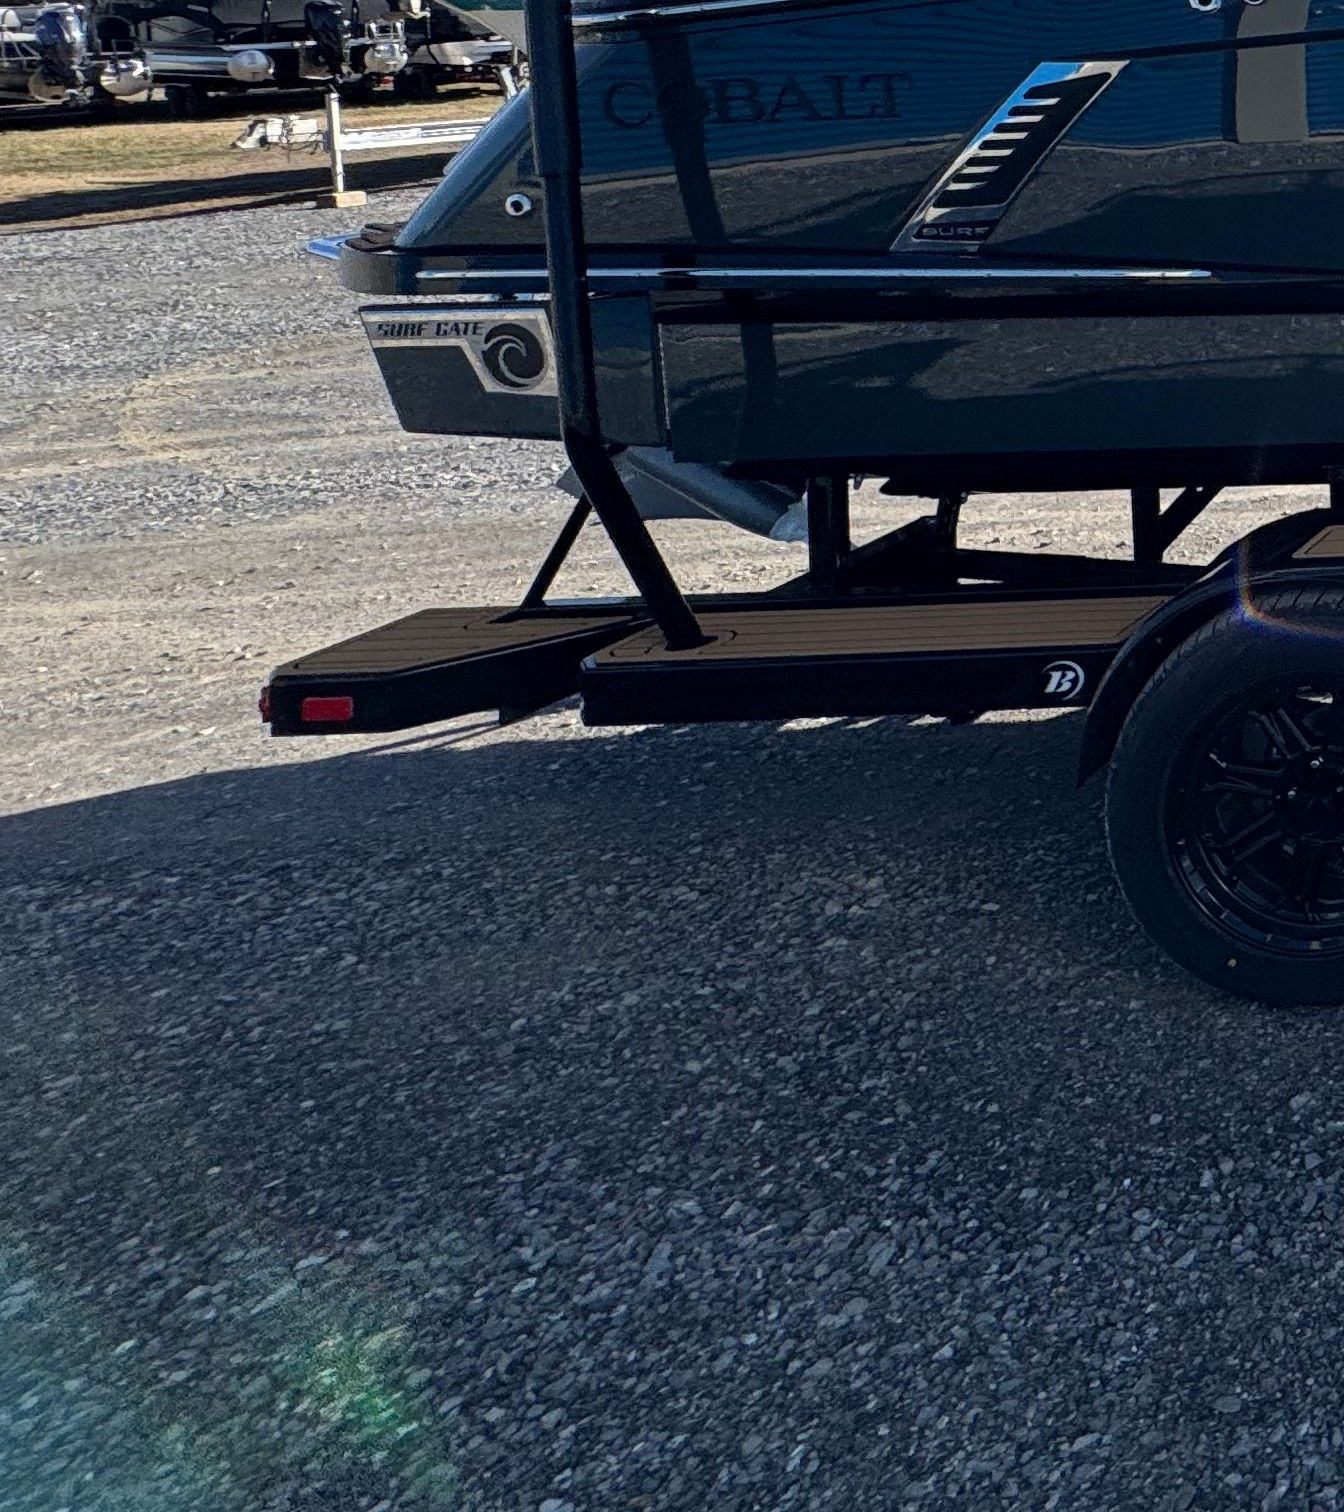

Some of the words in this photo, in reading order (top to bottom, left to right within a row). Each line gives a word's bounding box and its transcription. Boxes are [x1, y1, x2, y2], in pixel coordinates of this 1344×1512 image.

[604, 72, 911, 129] COBALT
[376, 322, 429, 338] SURF
[435, 321, 485, 337] GATE
